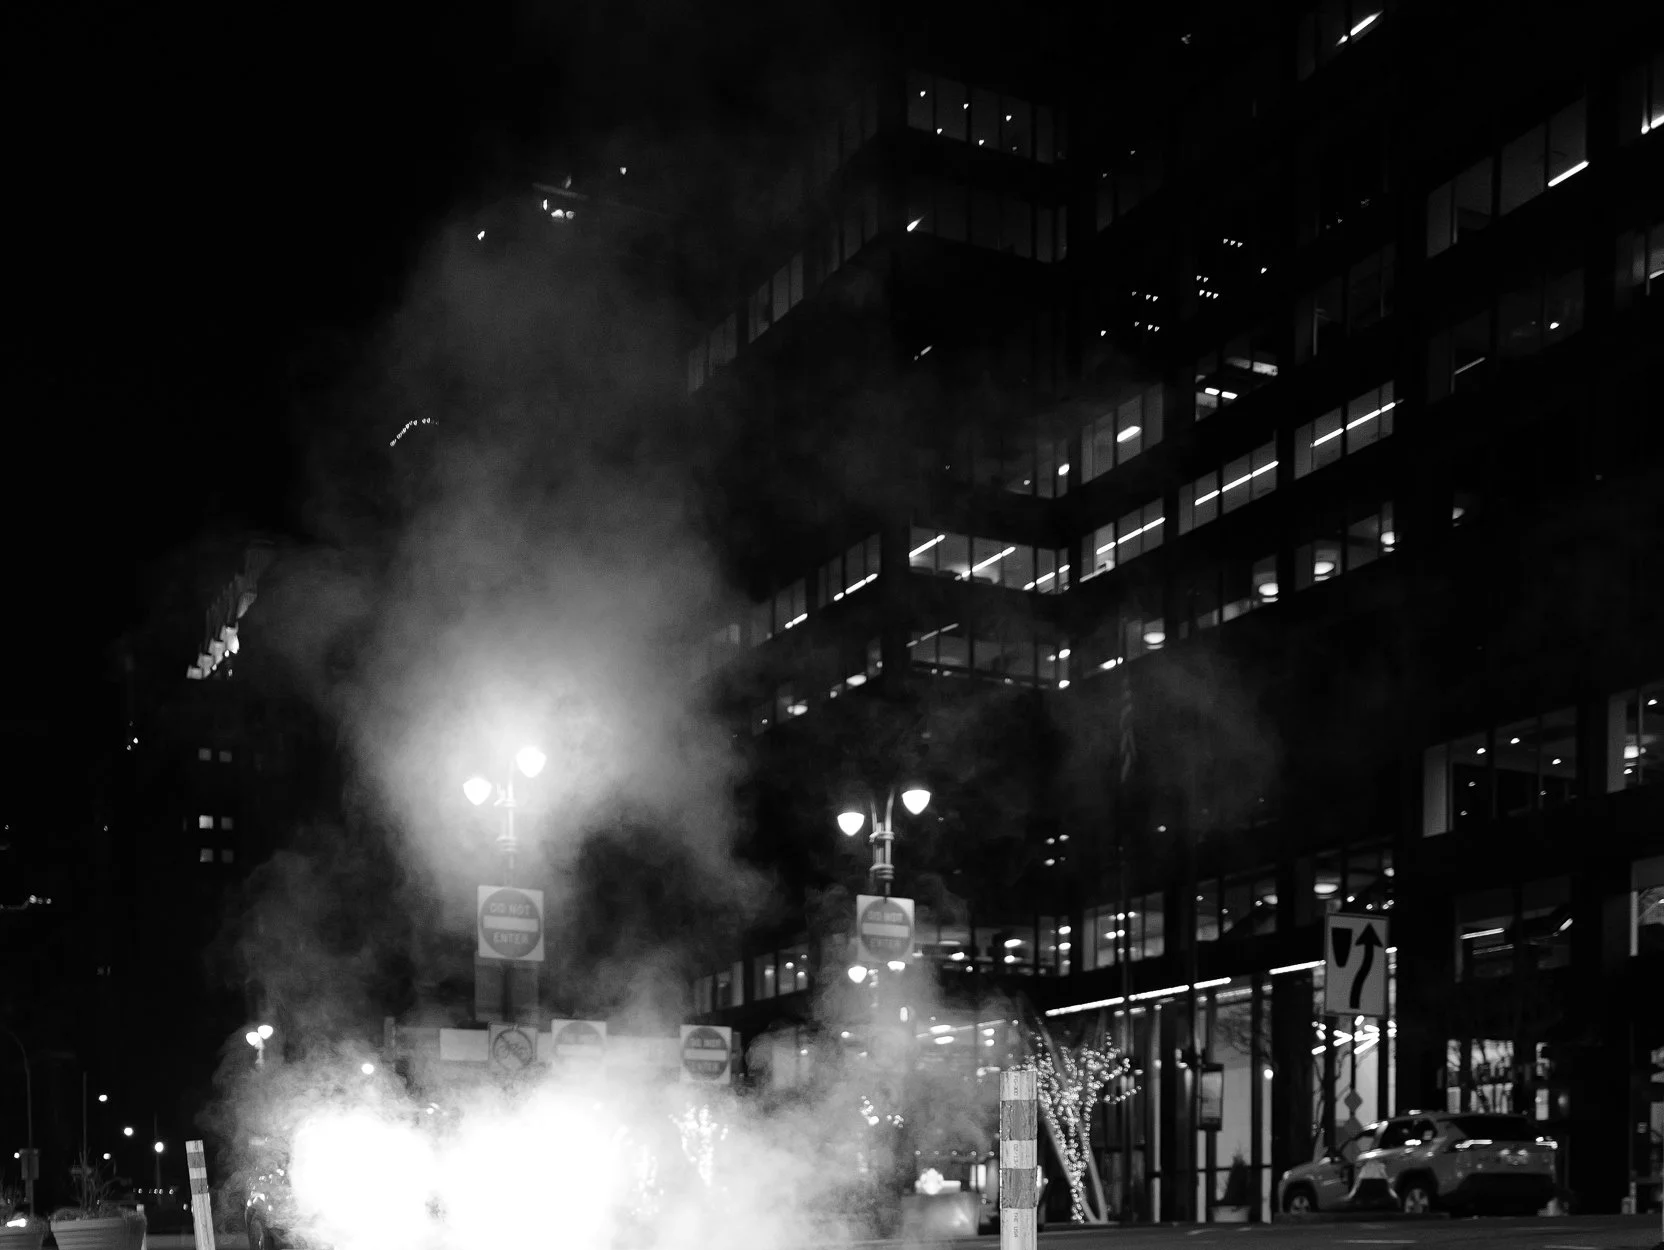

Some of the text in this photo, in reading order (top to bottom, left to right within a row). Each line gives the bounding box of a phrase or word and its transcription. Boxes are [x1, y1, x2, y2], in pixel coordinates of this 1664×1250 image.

[489, 902, 531, 916] DO NOT
[493, 931, 529, 945] ENTER
